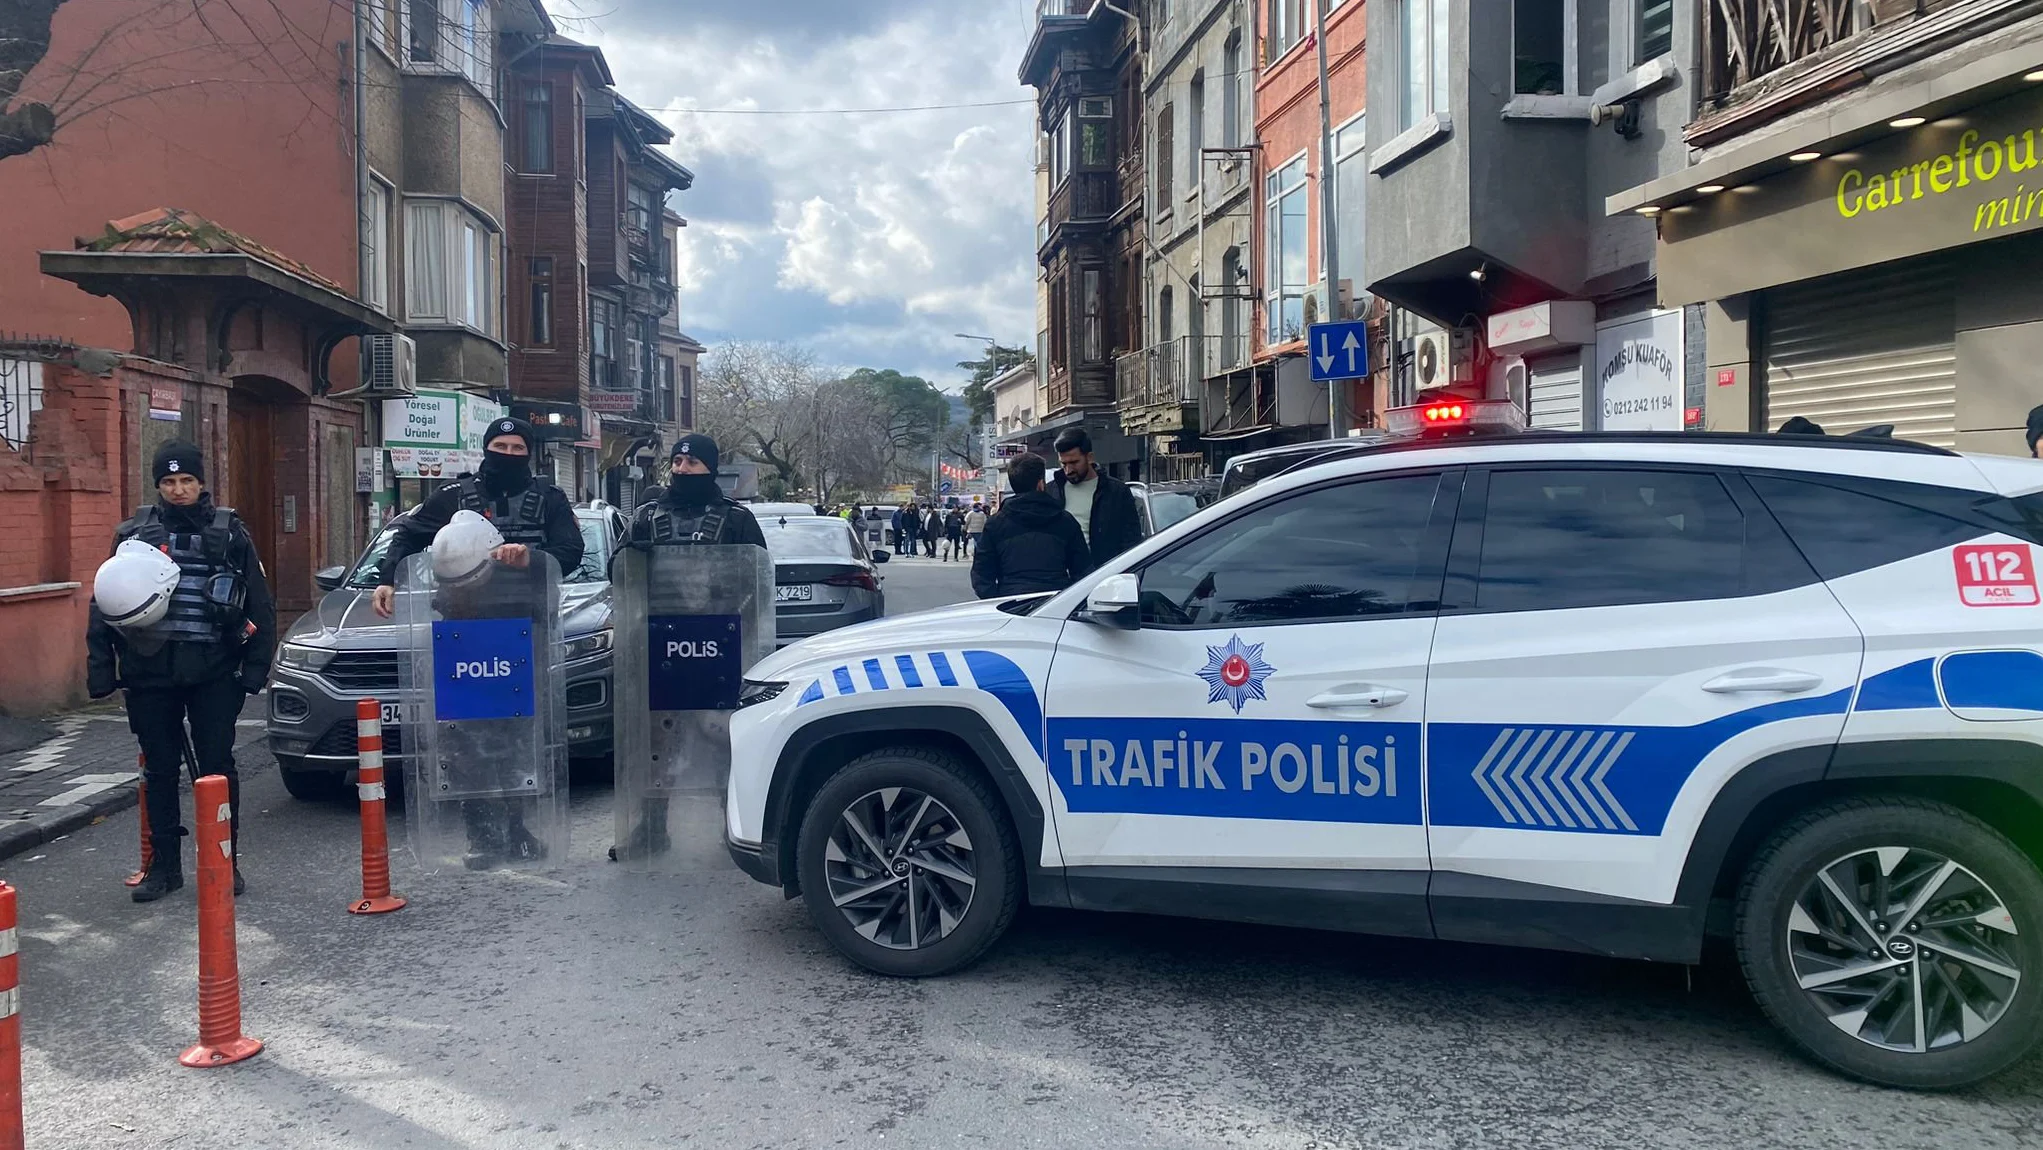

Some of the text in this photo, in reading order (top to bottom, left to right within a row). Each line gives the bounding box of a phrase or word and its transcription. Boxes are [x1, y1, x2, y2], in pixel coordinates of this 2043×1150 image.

[1837, 128, 2043, 218] Carrefou
[1635, 343, 1673, 381] KUAFÖR
[404, 399, 440, 411] Yöresel
[1613, 394, 1673, 415] 0212 242 11 94
[409, 414, 436, 427] Doğal
[404, 425, 440, 439] Ürünler
[988, 427, 999, 459] PAIS
[1965, 551, 2025, 582] 112
[786, 586, 810, 597] 7219
[456, 656, 511, 679] POLİS
[382, 705, 402, 723] 34
[1064, 730, 1397, 798] TRAFİK POLİSİ
